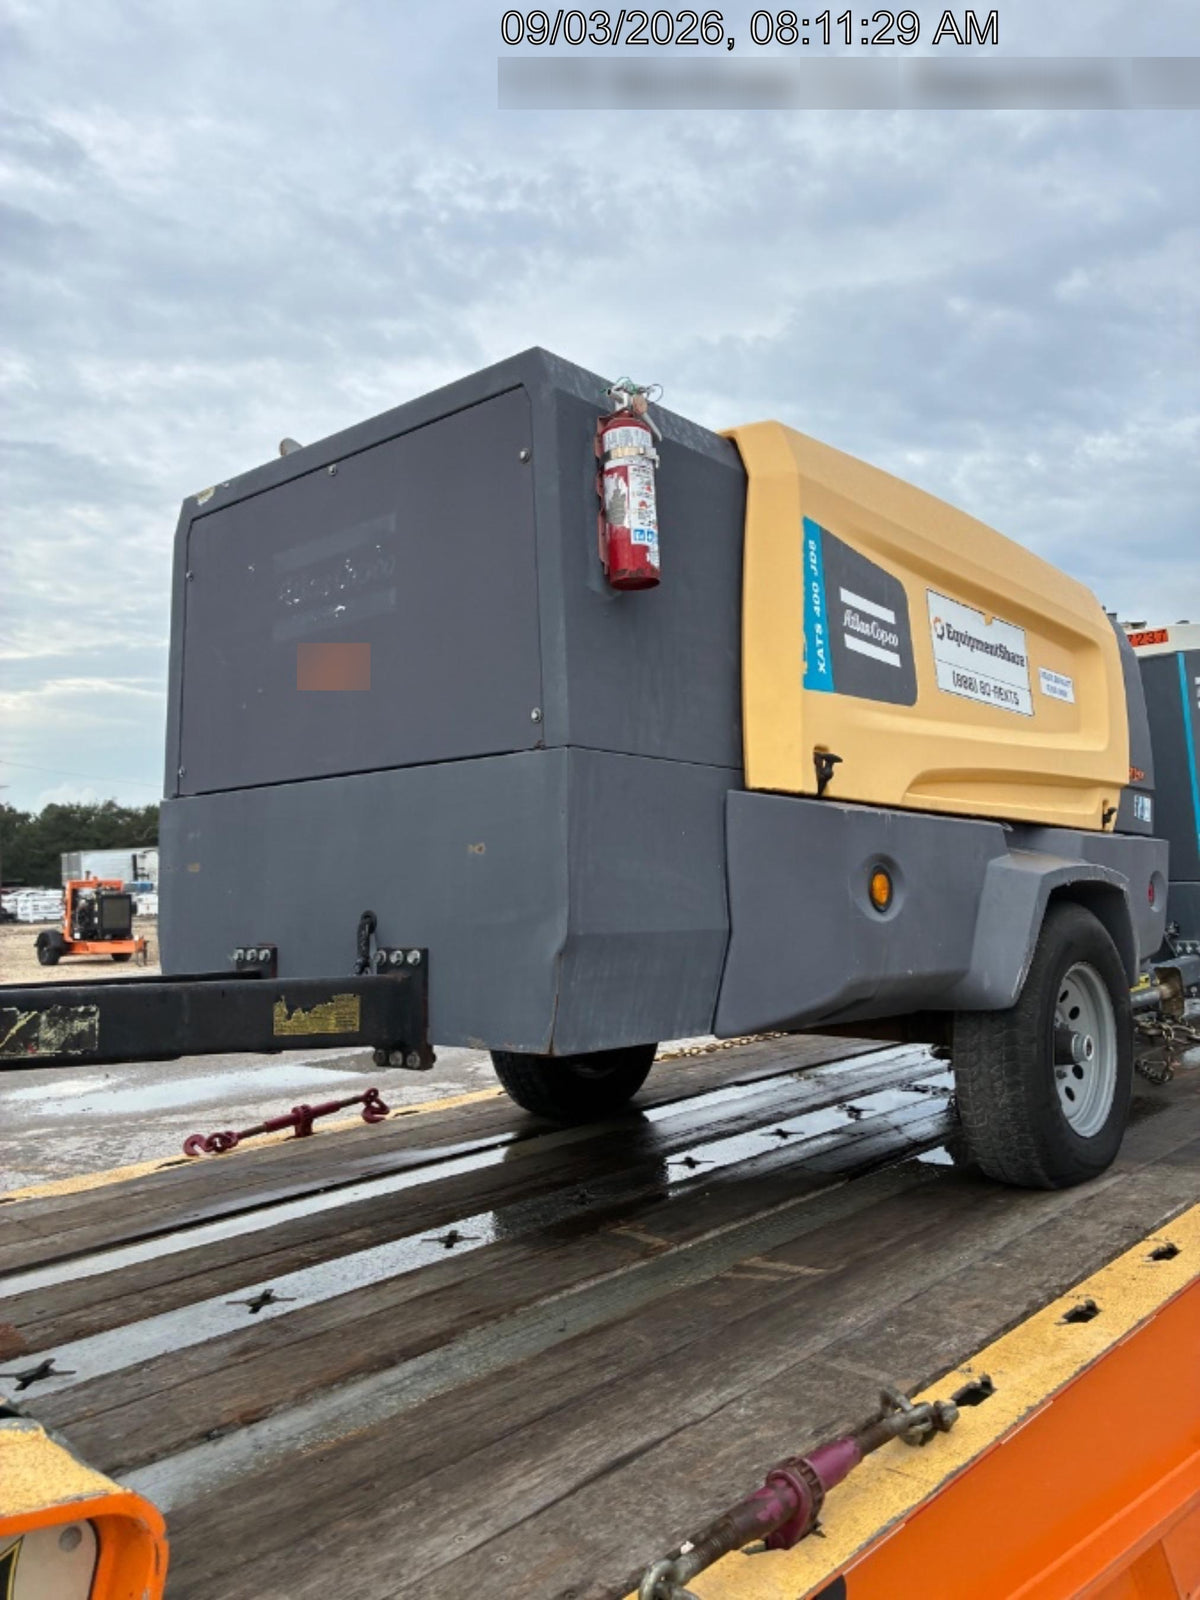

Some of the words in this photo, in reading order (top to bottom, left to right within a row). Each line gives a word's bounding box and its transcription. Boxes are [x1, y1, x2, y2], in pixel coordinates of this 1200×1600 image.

[811, 582, 820, 617] 400
[814, 623, 826, 674] XATS
[945, 622, 1025, 667] EquipmentShare
